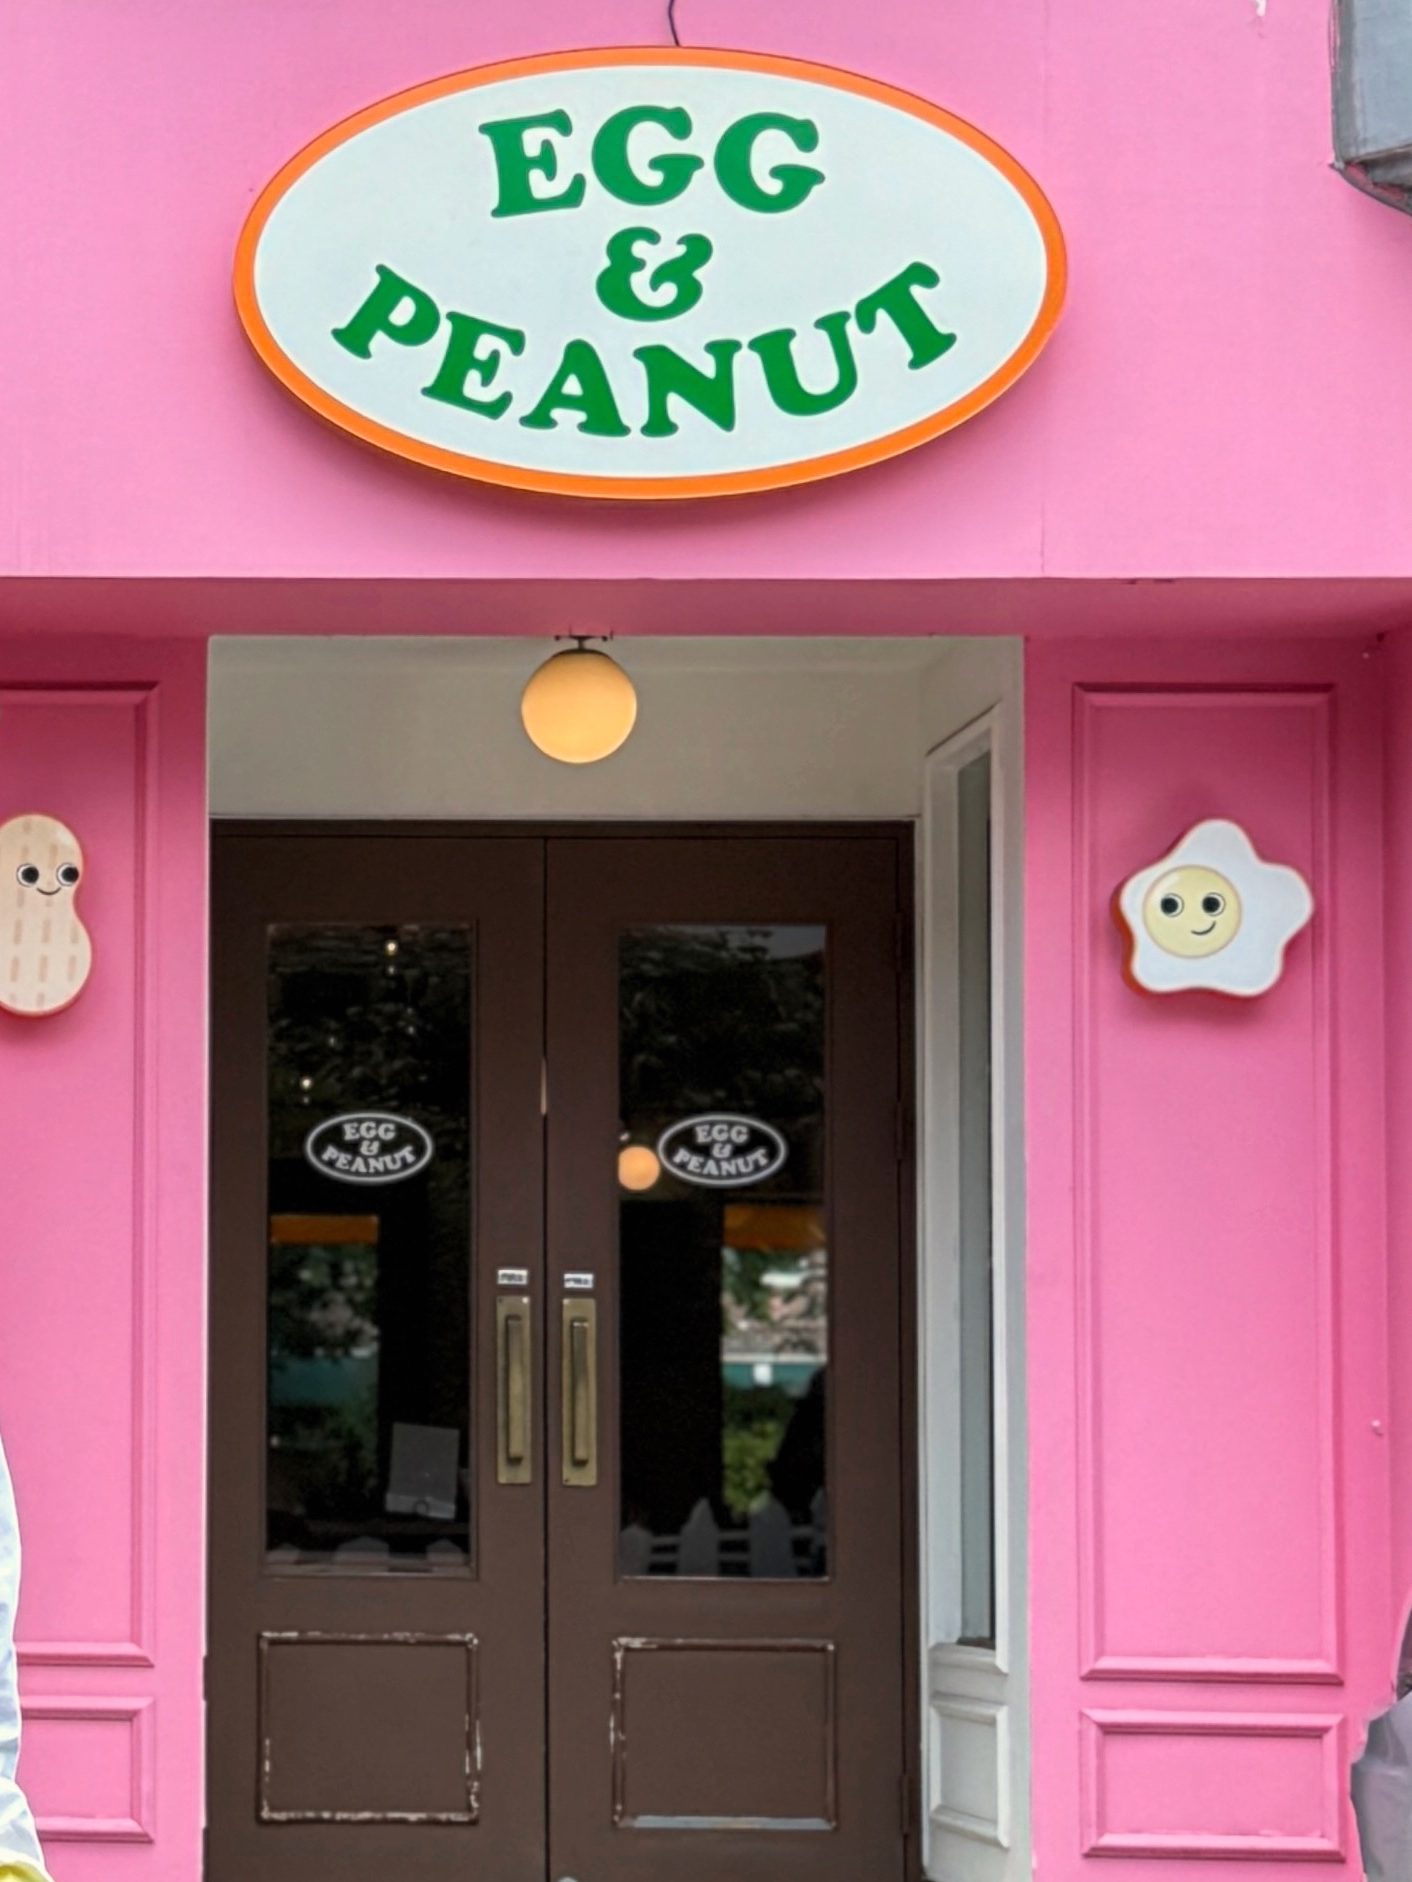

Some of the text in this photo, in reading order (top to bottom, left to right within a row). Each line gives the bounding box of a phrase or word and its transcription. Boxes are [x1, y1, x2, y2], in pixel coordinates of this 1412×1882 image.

[479, 105, 826, 218] EGG
[596, 226, 714, 322] &
[331, 261, 958, 438] PEANUT
[342, 1121, 396, 1141] EGG
[695, 1123, 749, 1143] EGG
[321, 1145, 416, 1173] PEANUT
[360, 1140, 380, 1156] &
[673, 1148, 768, 1176] PEANUT
[712, 1142, 732, 1158] &
